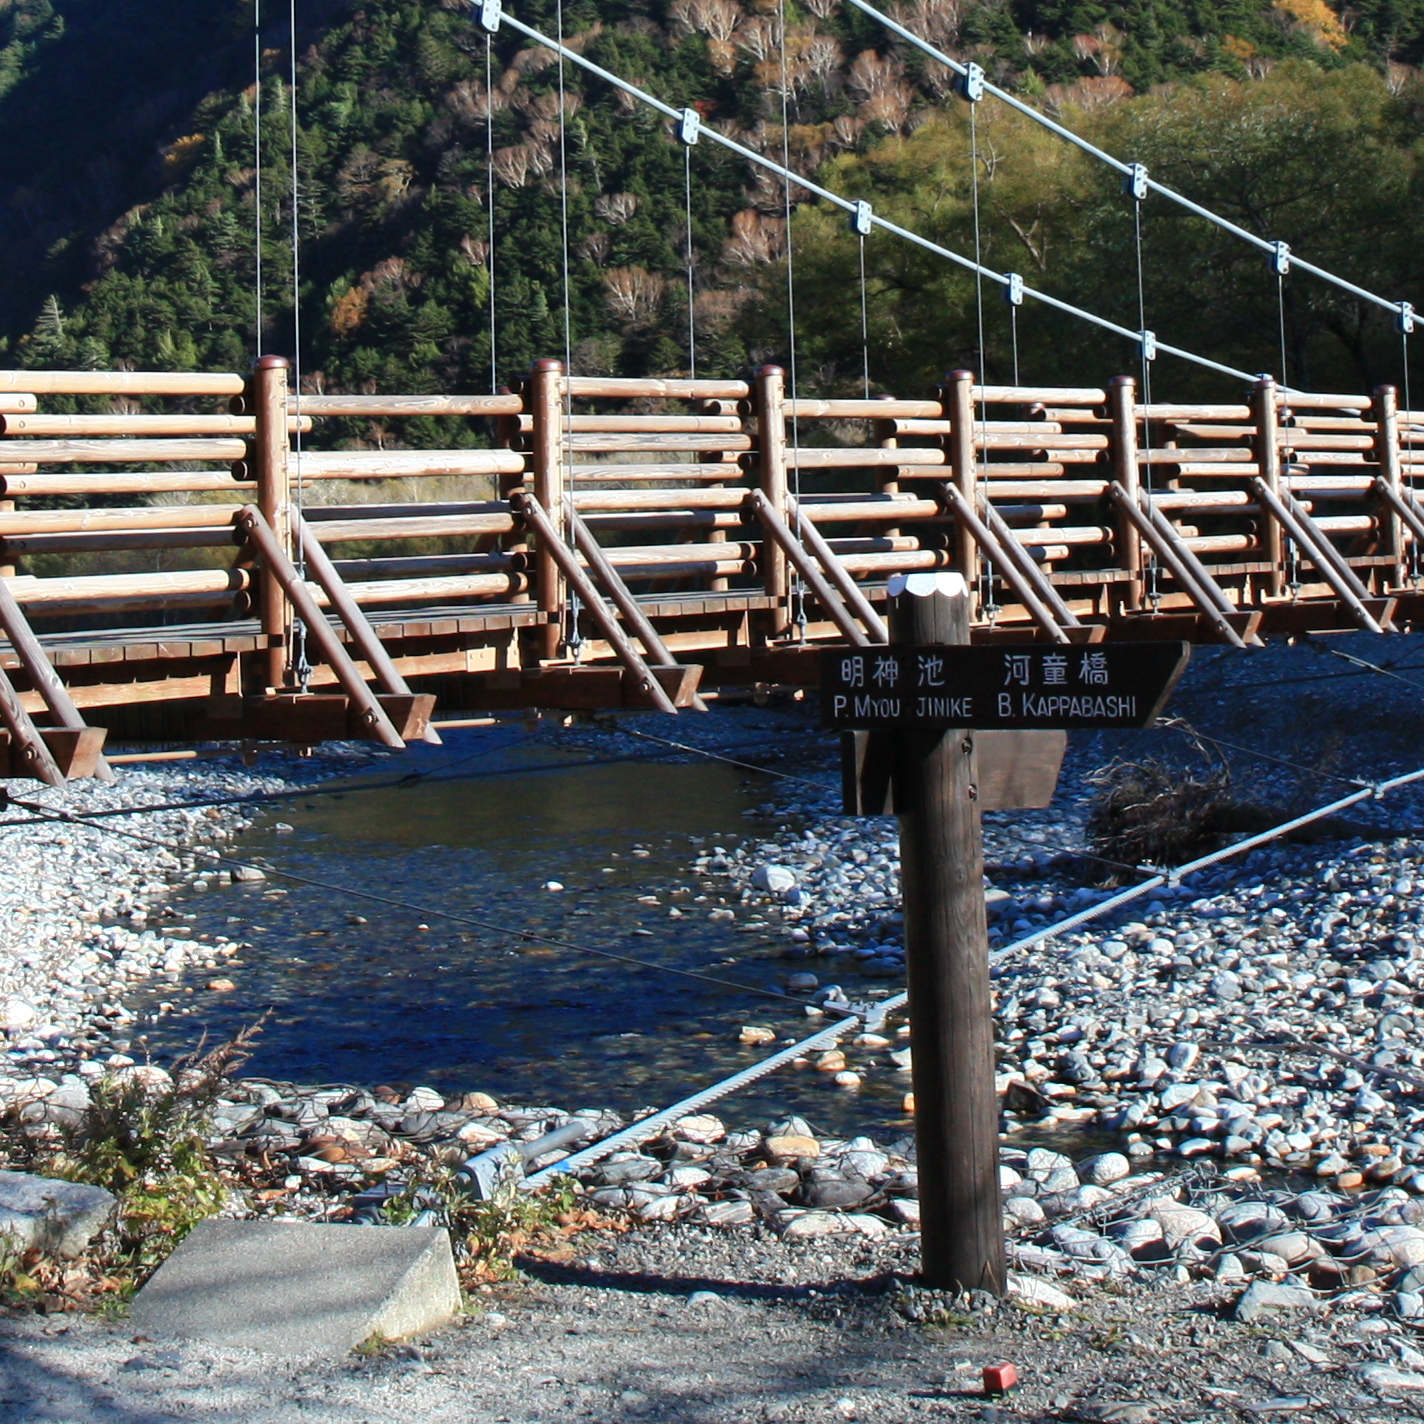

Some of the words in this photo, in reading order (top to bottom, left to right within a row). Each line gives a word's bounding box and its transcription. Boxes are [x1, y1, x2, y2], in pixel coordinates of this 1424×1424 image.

[840, 654, 946, 688] 明神池
[1003, 651, 1108, 686] 河童橋
[833, 695, 848, 718] P.
[916, 697, 973, 718] JINIKE
[997, 693, 1016, 718] B.
[1022, 692, 1137, 718] KAPPABASHI
